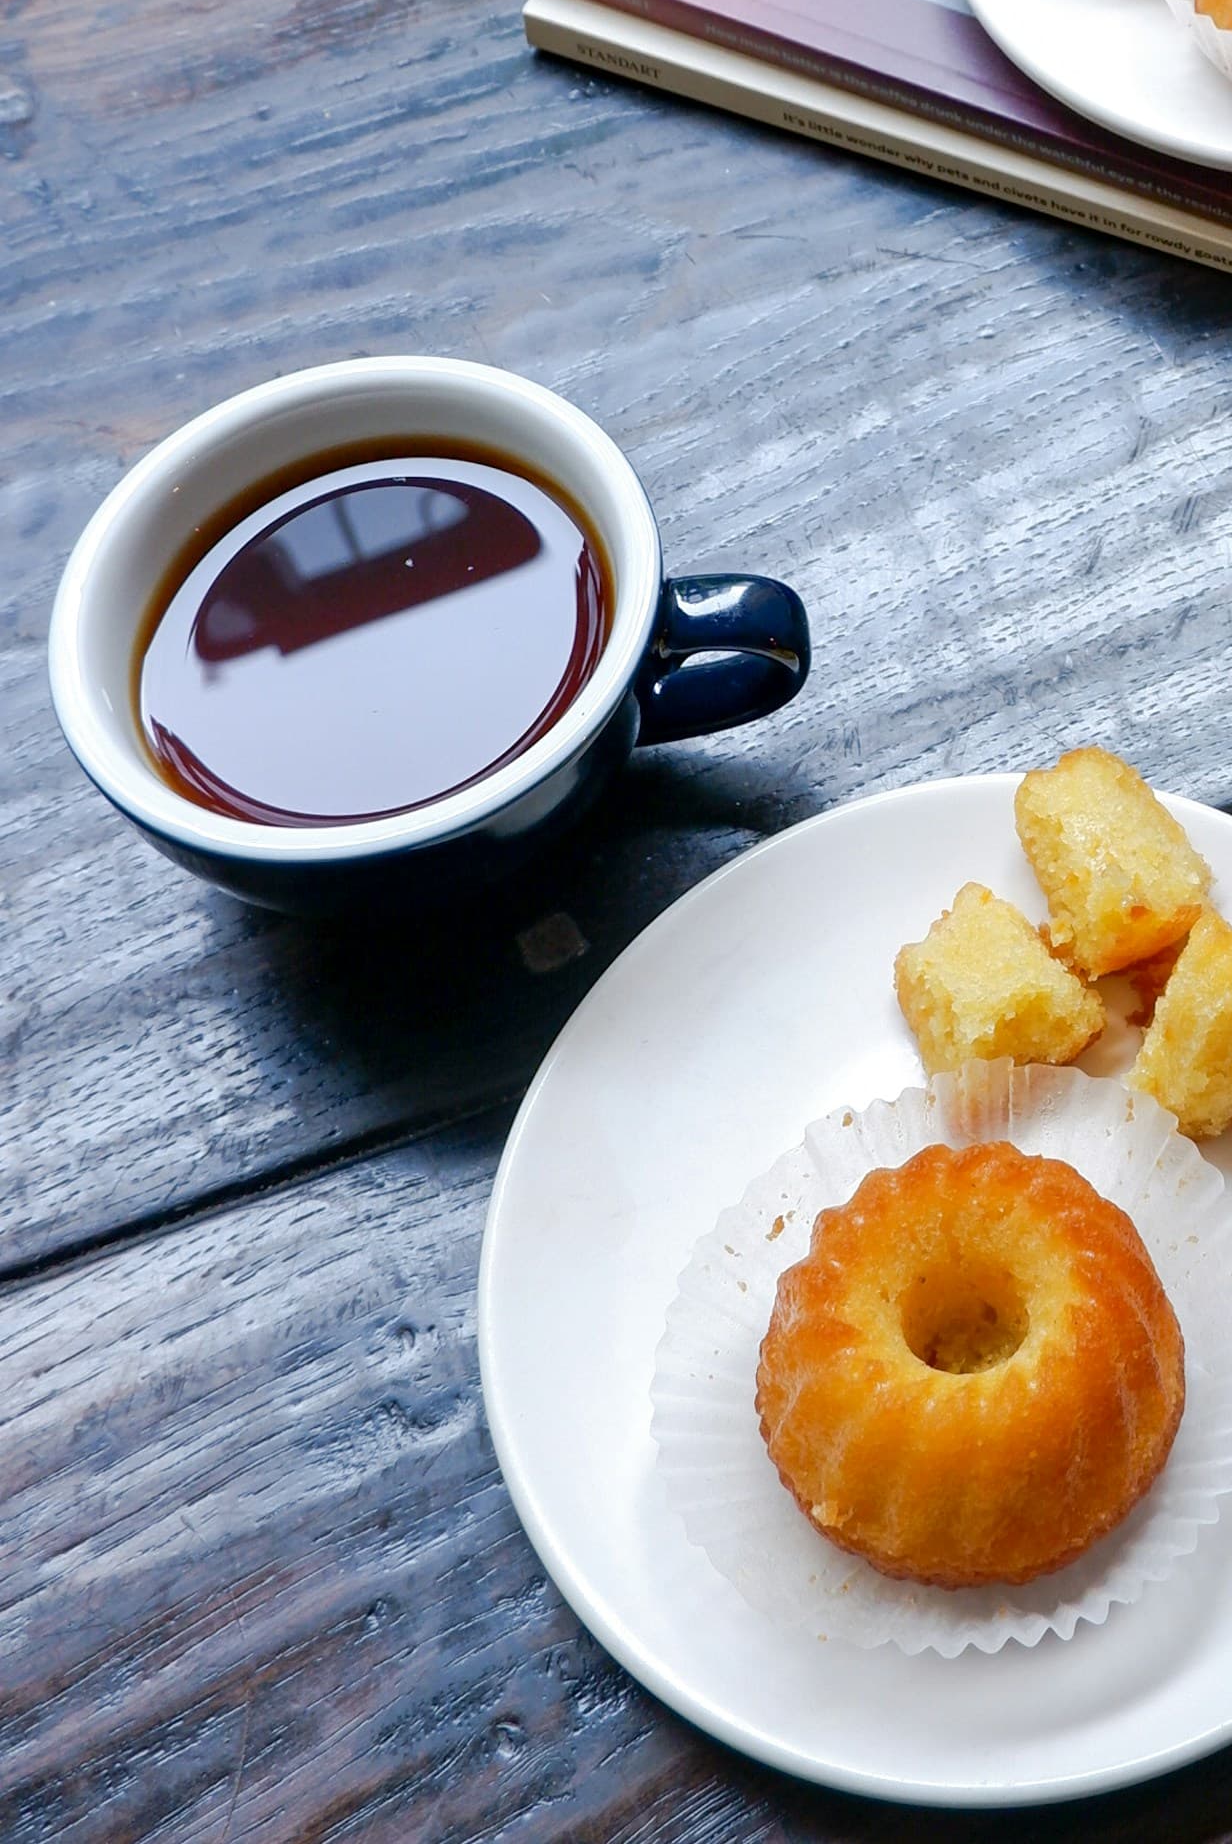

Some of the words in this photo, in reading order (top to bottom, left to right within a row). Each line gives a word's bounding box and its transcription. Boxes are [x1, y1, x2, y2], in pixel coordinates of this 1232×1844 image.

[576, 43, 662, 80] STANDART
[808, 119, 843, 139] little
[846, 133, 900, 158] wonder
[903, 153, 934, 171] why
[937, 164, 970, 181] pets
[973, 174, 1001, 191] and
[1003, 186, 1047, 206] civets
[1051, 199, 1086, 218] have
[1089, 211, 1101, 223] it
[1103, 216, 1118, 229] in
[1120, 222, 1143, 237] for
[1145, 233, 1191, 255] rowdy
[965, 116, 1008, 140] under
[1011, 131, 1037, 150] the
[1108, 169, 1135, 187] eye
[1157, 186, 1182, 203] the
